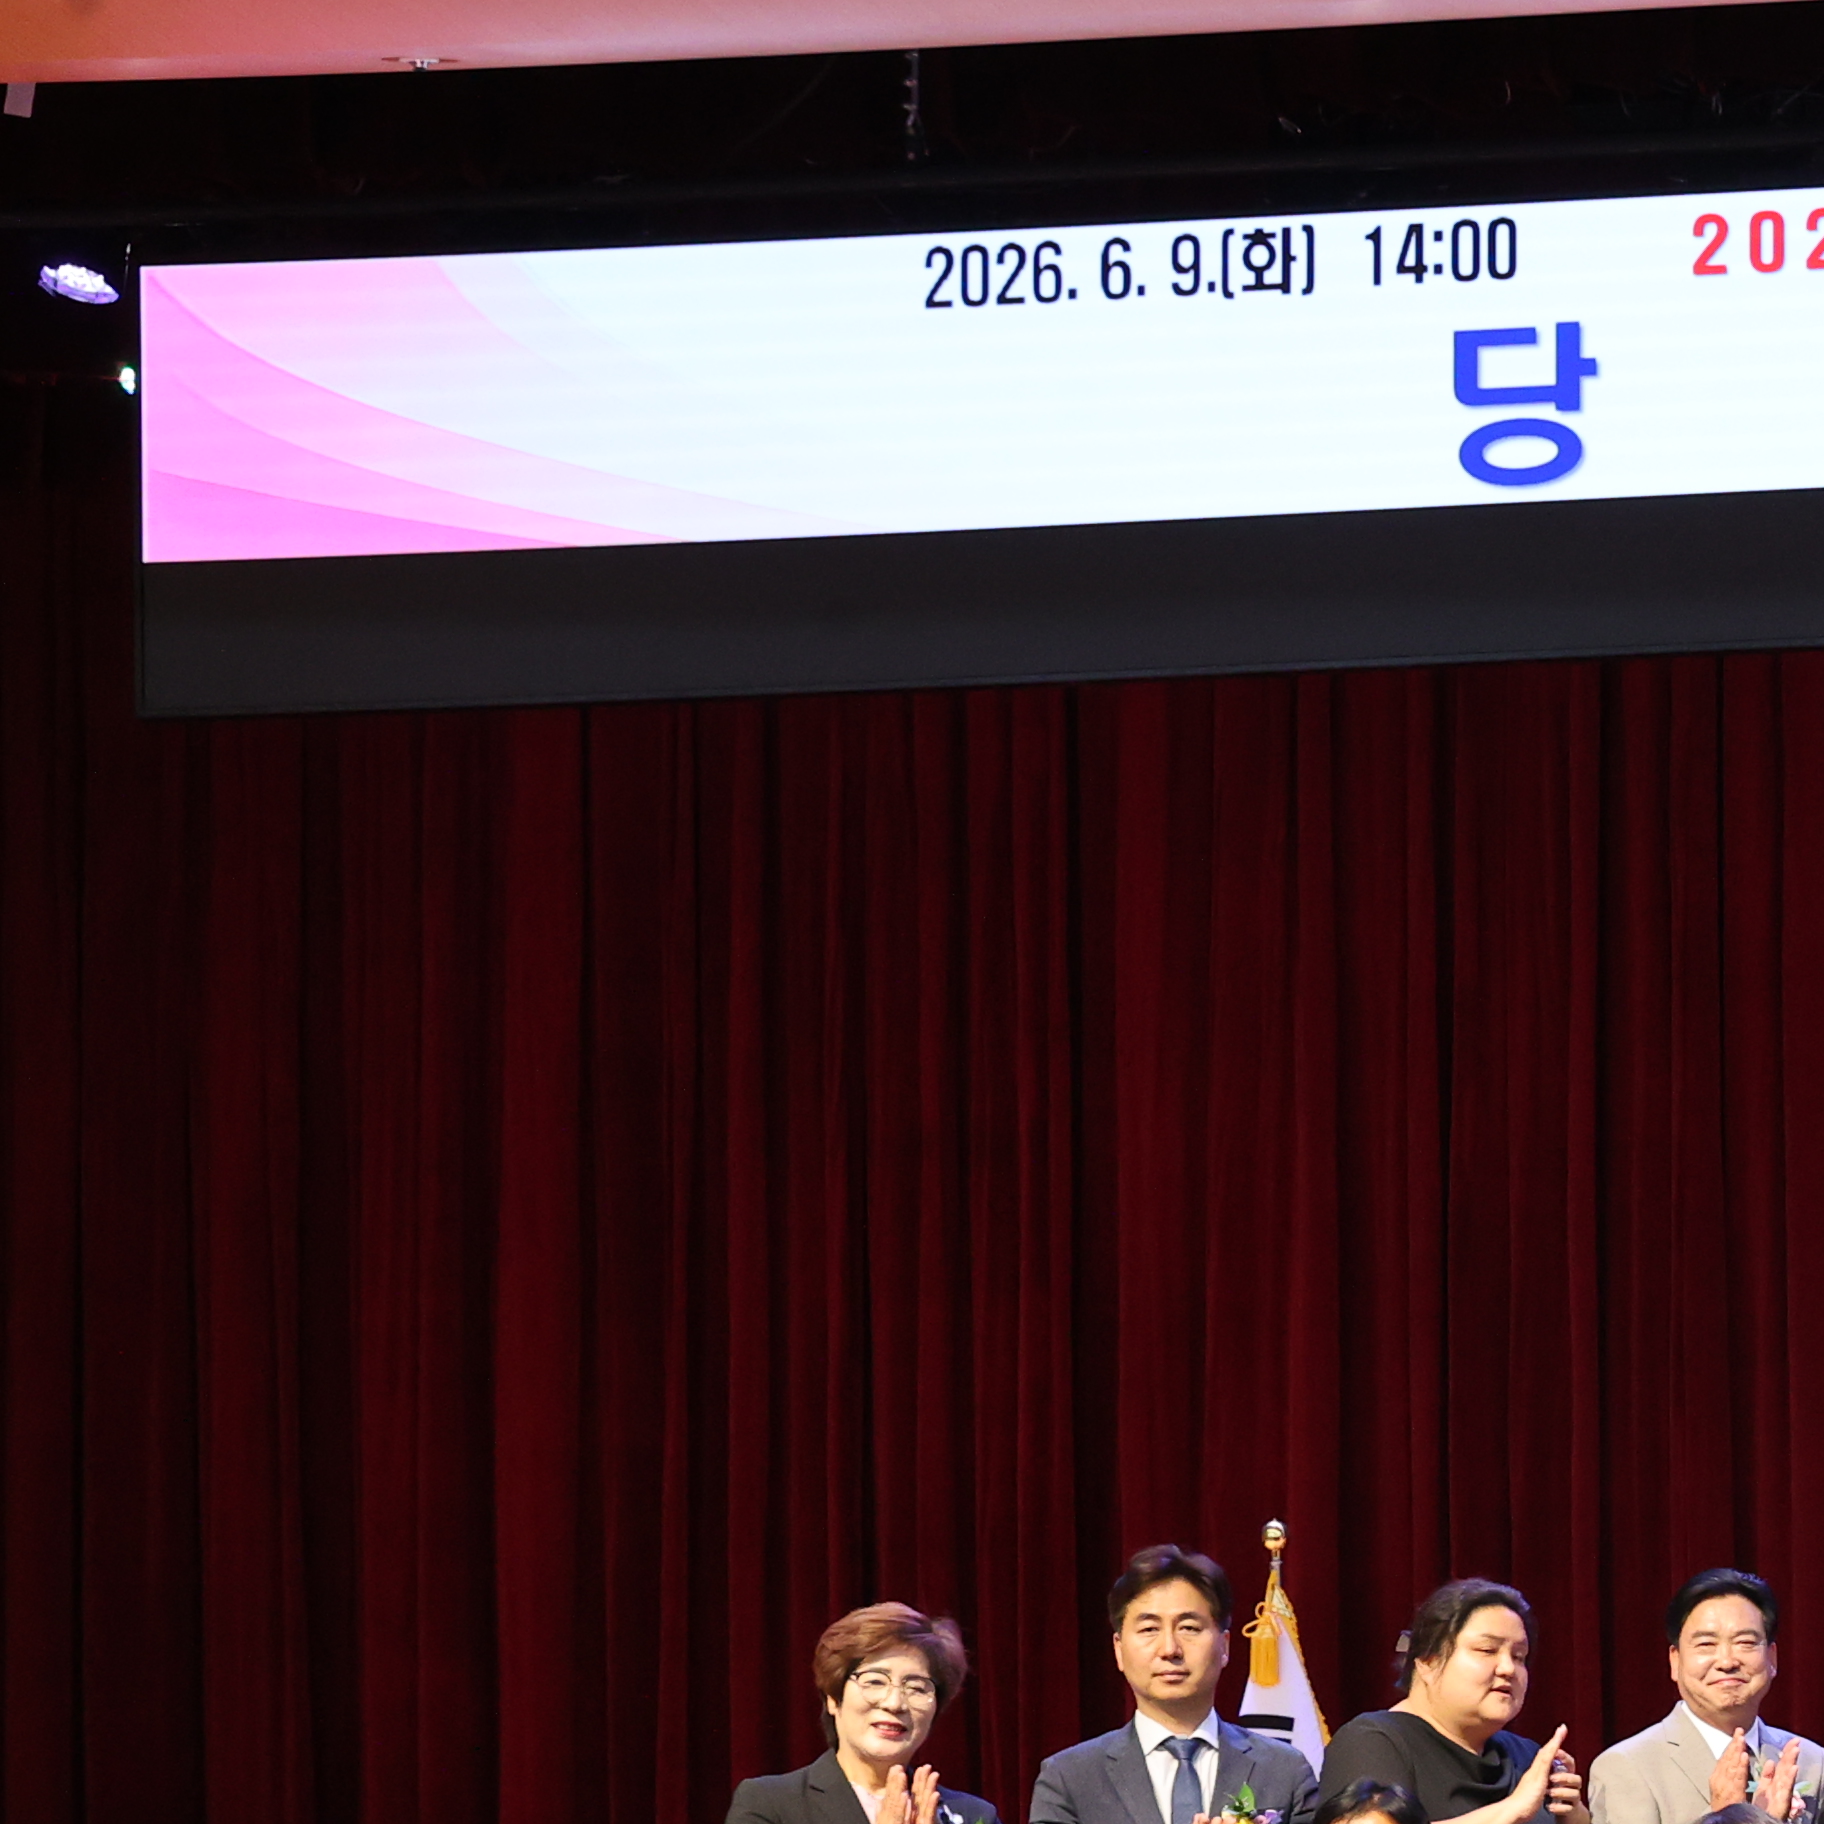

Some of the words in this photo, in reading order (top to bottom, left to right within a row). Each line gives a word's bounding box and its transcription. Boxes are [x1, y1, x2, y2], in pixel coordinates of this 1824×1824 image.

[923, 238, 1079, 310] 2026.
[1099, 235, 1147, 301] 6.
[1363, 215, 1519, 287] 14:00
